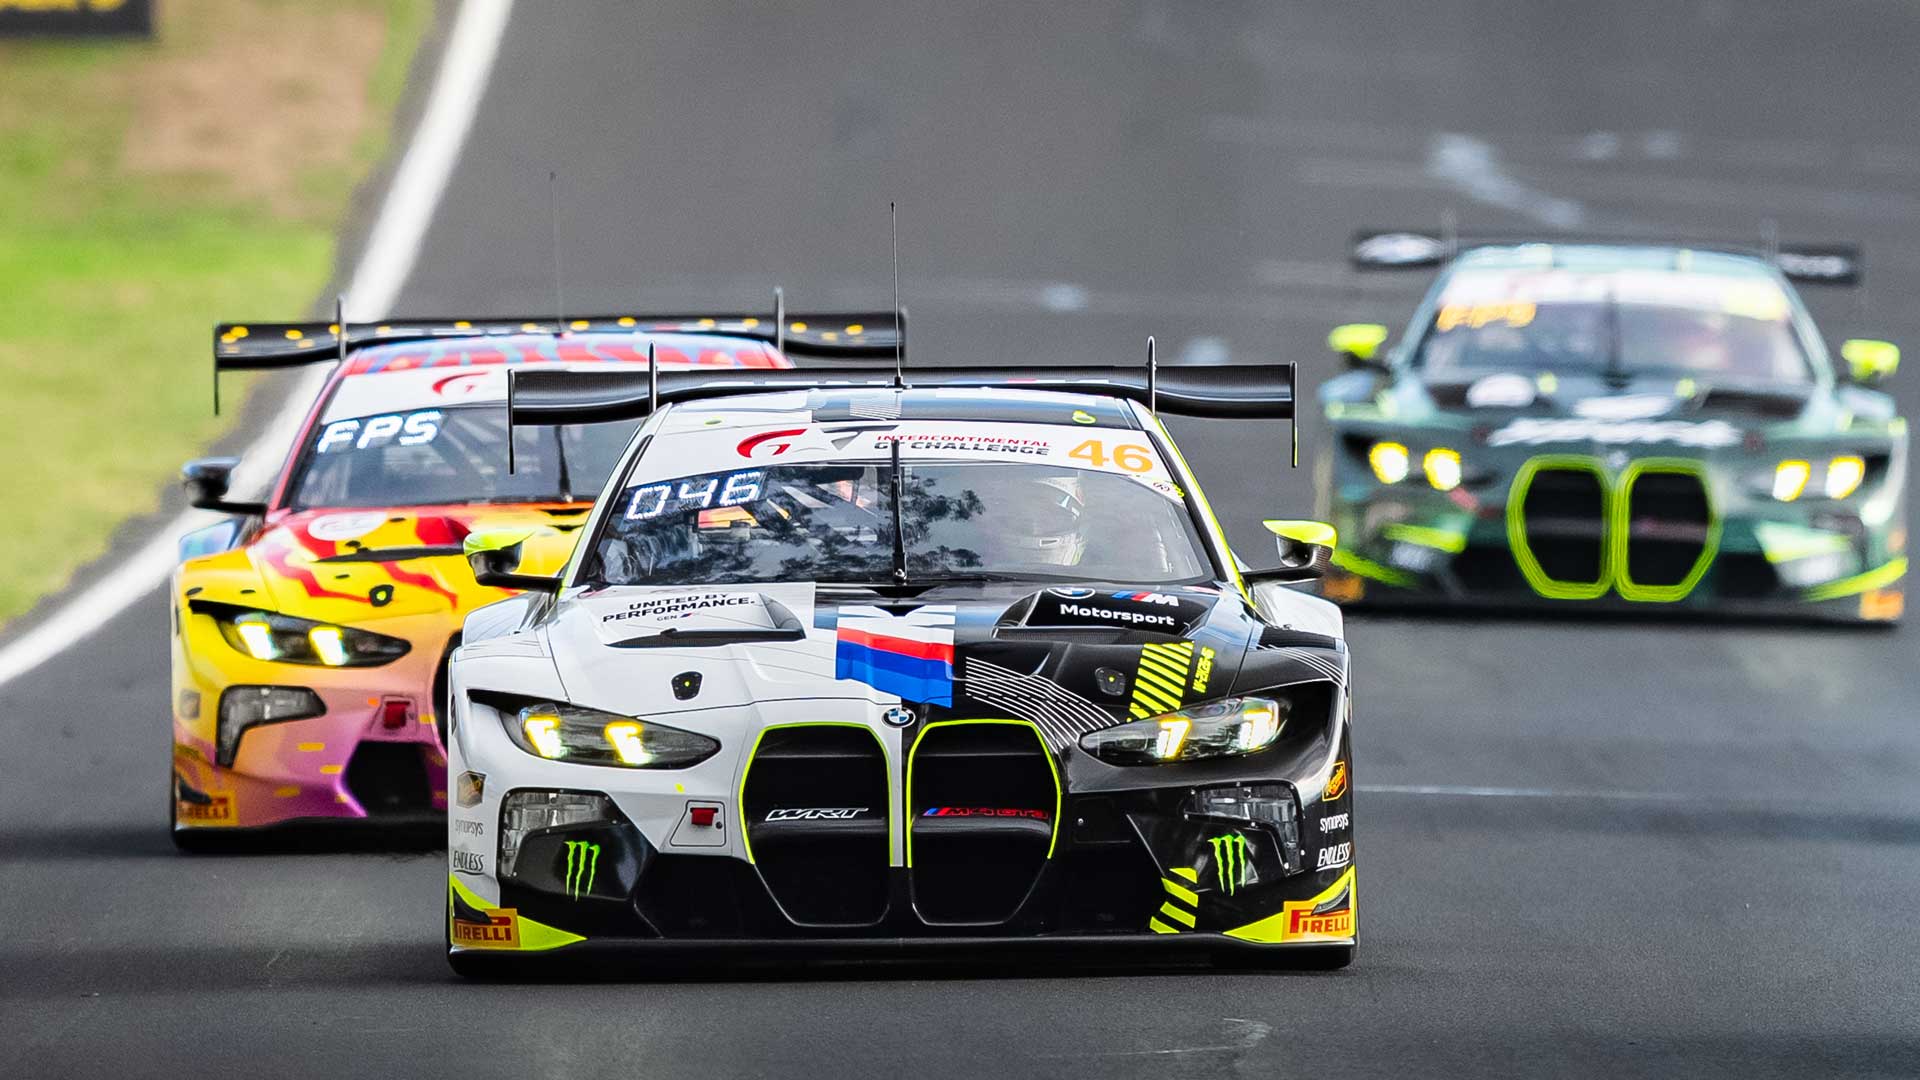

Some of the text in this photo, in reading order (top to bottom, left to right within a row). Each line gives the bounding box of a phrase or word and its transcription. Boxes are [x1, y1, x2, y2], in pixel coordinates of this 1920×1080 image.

[317, 410, 442, 453] FPS
[877, 435, 1051, 447] INTERCONTINENTAL
[910, 441, 1050, 456] CHALLENGE
[1068, 440, 1153, 473] 46
[626, 471, 761, 520] 046
[602, 597, 756, 623] PERFORMANCE.
[629, 593, 728, 610] UNITED BY
[1060, 604, 1175, 626] Motorsport
[765, 807, 869, 821] WRT
[1320, 813, 1349, 834] SYNOPSYS
[455, 819, 484, 837] SYNOPSYS
[453, 850, 485, 872] ENDLESS
[1317, 841, 1351, 868] ENDLESS
[1289, 908, 1350, 933] PIRELLI
